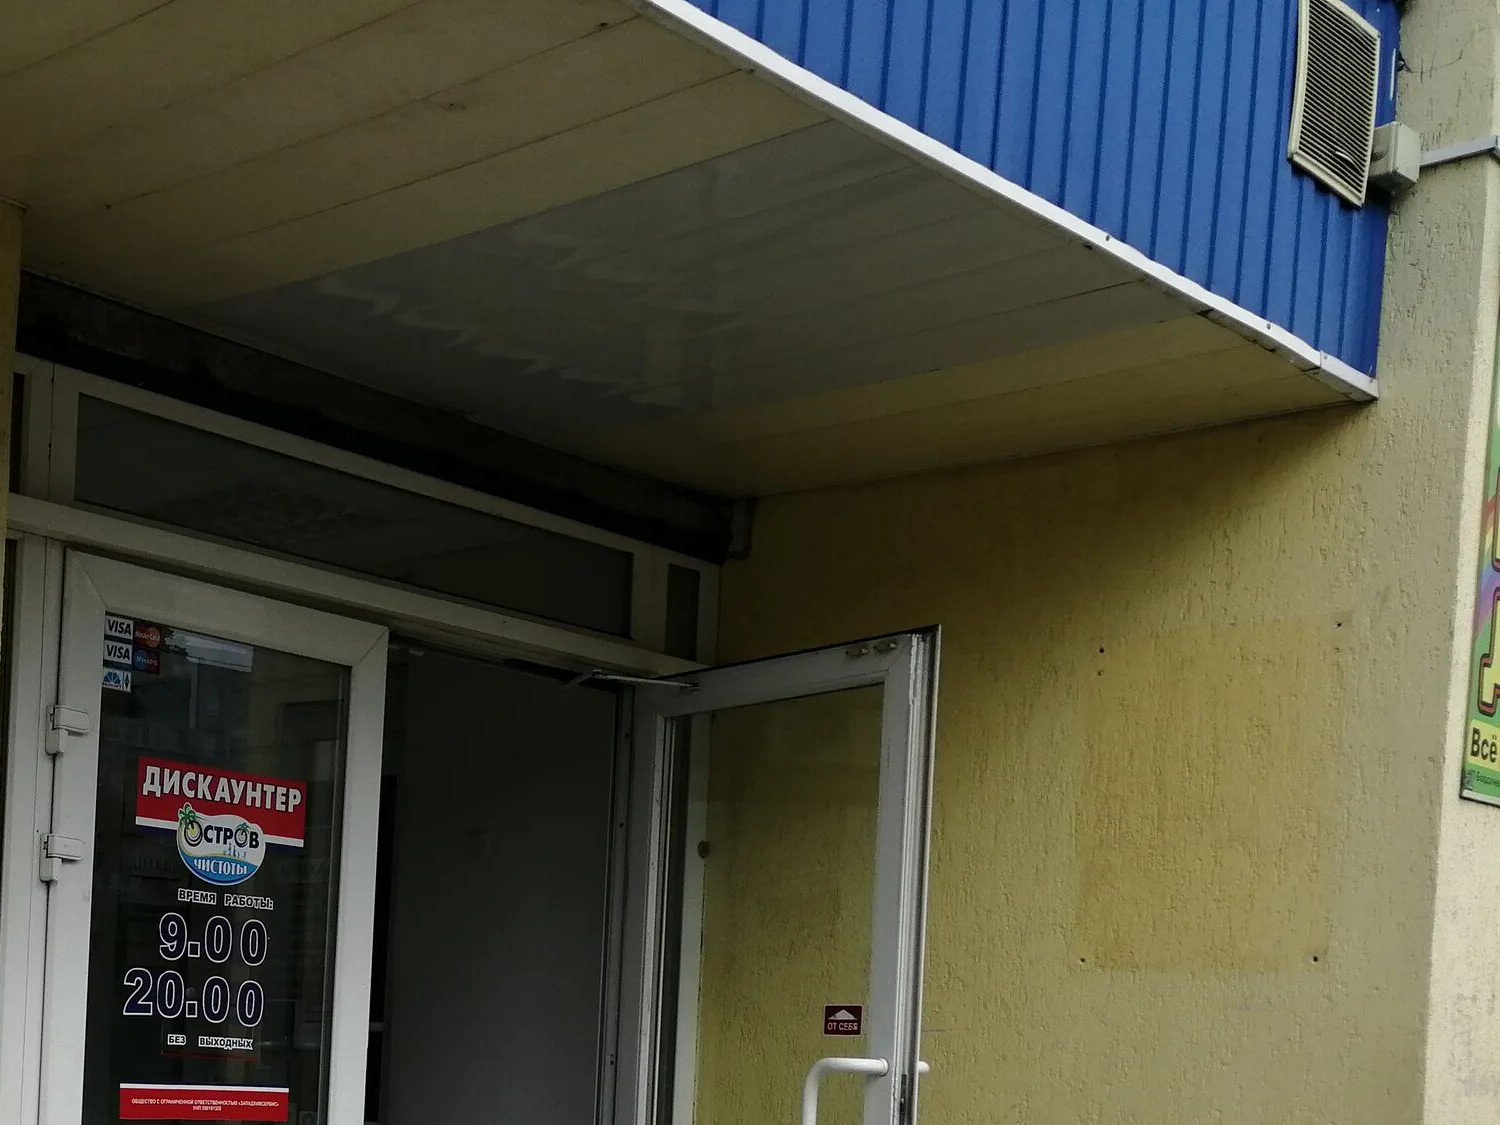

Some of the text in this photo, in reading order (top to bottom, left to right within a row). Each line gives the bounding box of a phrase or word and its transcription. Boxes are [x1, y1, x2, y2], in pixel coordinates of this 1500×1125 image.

[107, 619, 132, 636] VISA
[106, 644, 130, 661] VISA
[1470, 727, 1498, 763] Всё
[143, 766, 301, 812] ДИСКАУНТЕР
[184, 820, 260, 848] ОСТРОВ
[194, 859, 247, 875] ЧИСТОТЫ
[178, 888, 273, 910] ВРЕМЯ РАБОТЫ:
[159, 912, 267, 966] 9.00
[123, 967, 264, 1027] 20.00
[827, 1022, 837, 1031] ОТ
[167, 1034, 253, 1050] БЕЗ ВЫХОДНЫХ
